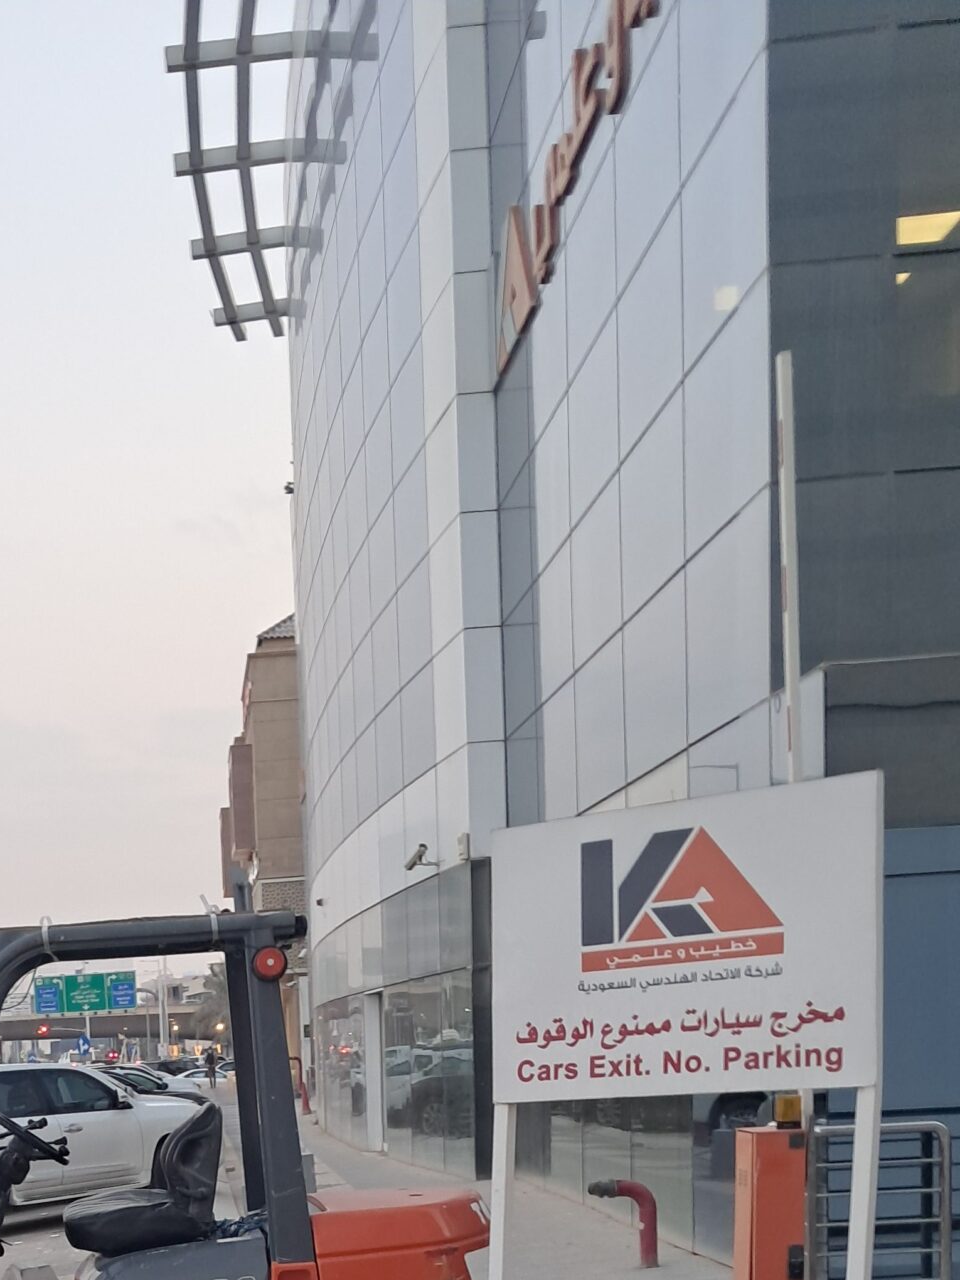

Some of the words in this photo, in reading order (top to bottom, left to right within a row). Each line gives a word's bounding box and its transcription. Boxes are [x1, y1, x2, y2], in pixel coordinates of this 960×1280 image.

[688, 938, 758, 959] خطيب
[700, 967, 742, 983] الاتحاد
[743, 960, 784, 979] شركة
[577, 977, 638, 995] السعودية
[515, 1016, 595, 1050] الوقوف
[599, 1013, 672, 1050] ممنوع
[679, 1006, 763, 1038] سيارات
[769, 1000, 846, 1038] مخرج
[516, 1059, 579, 1083] Cars
[589, 1053, 651, 1079] Exit.
[662, 1049, 711, 1075] No.
[722, 1042, 844, 1073] Parking
